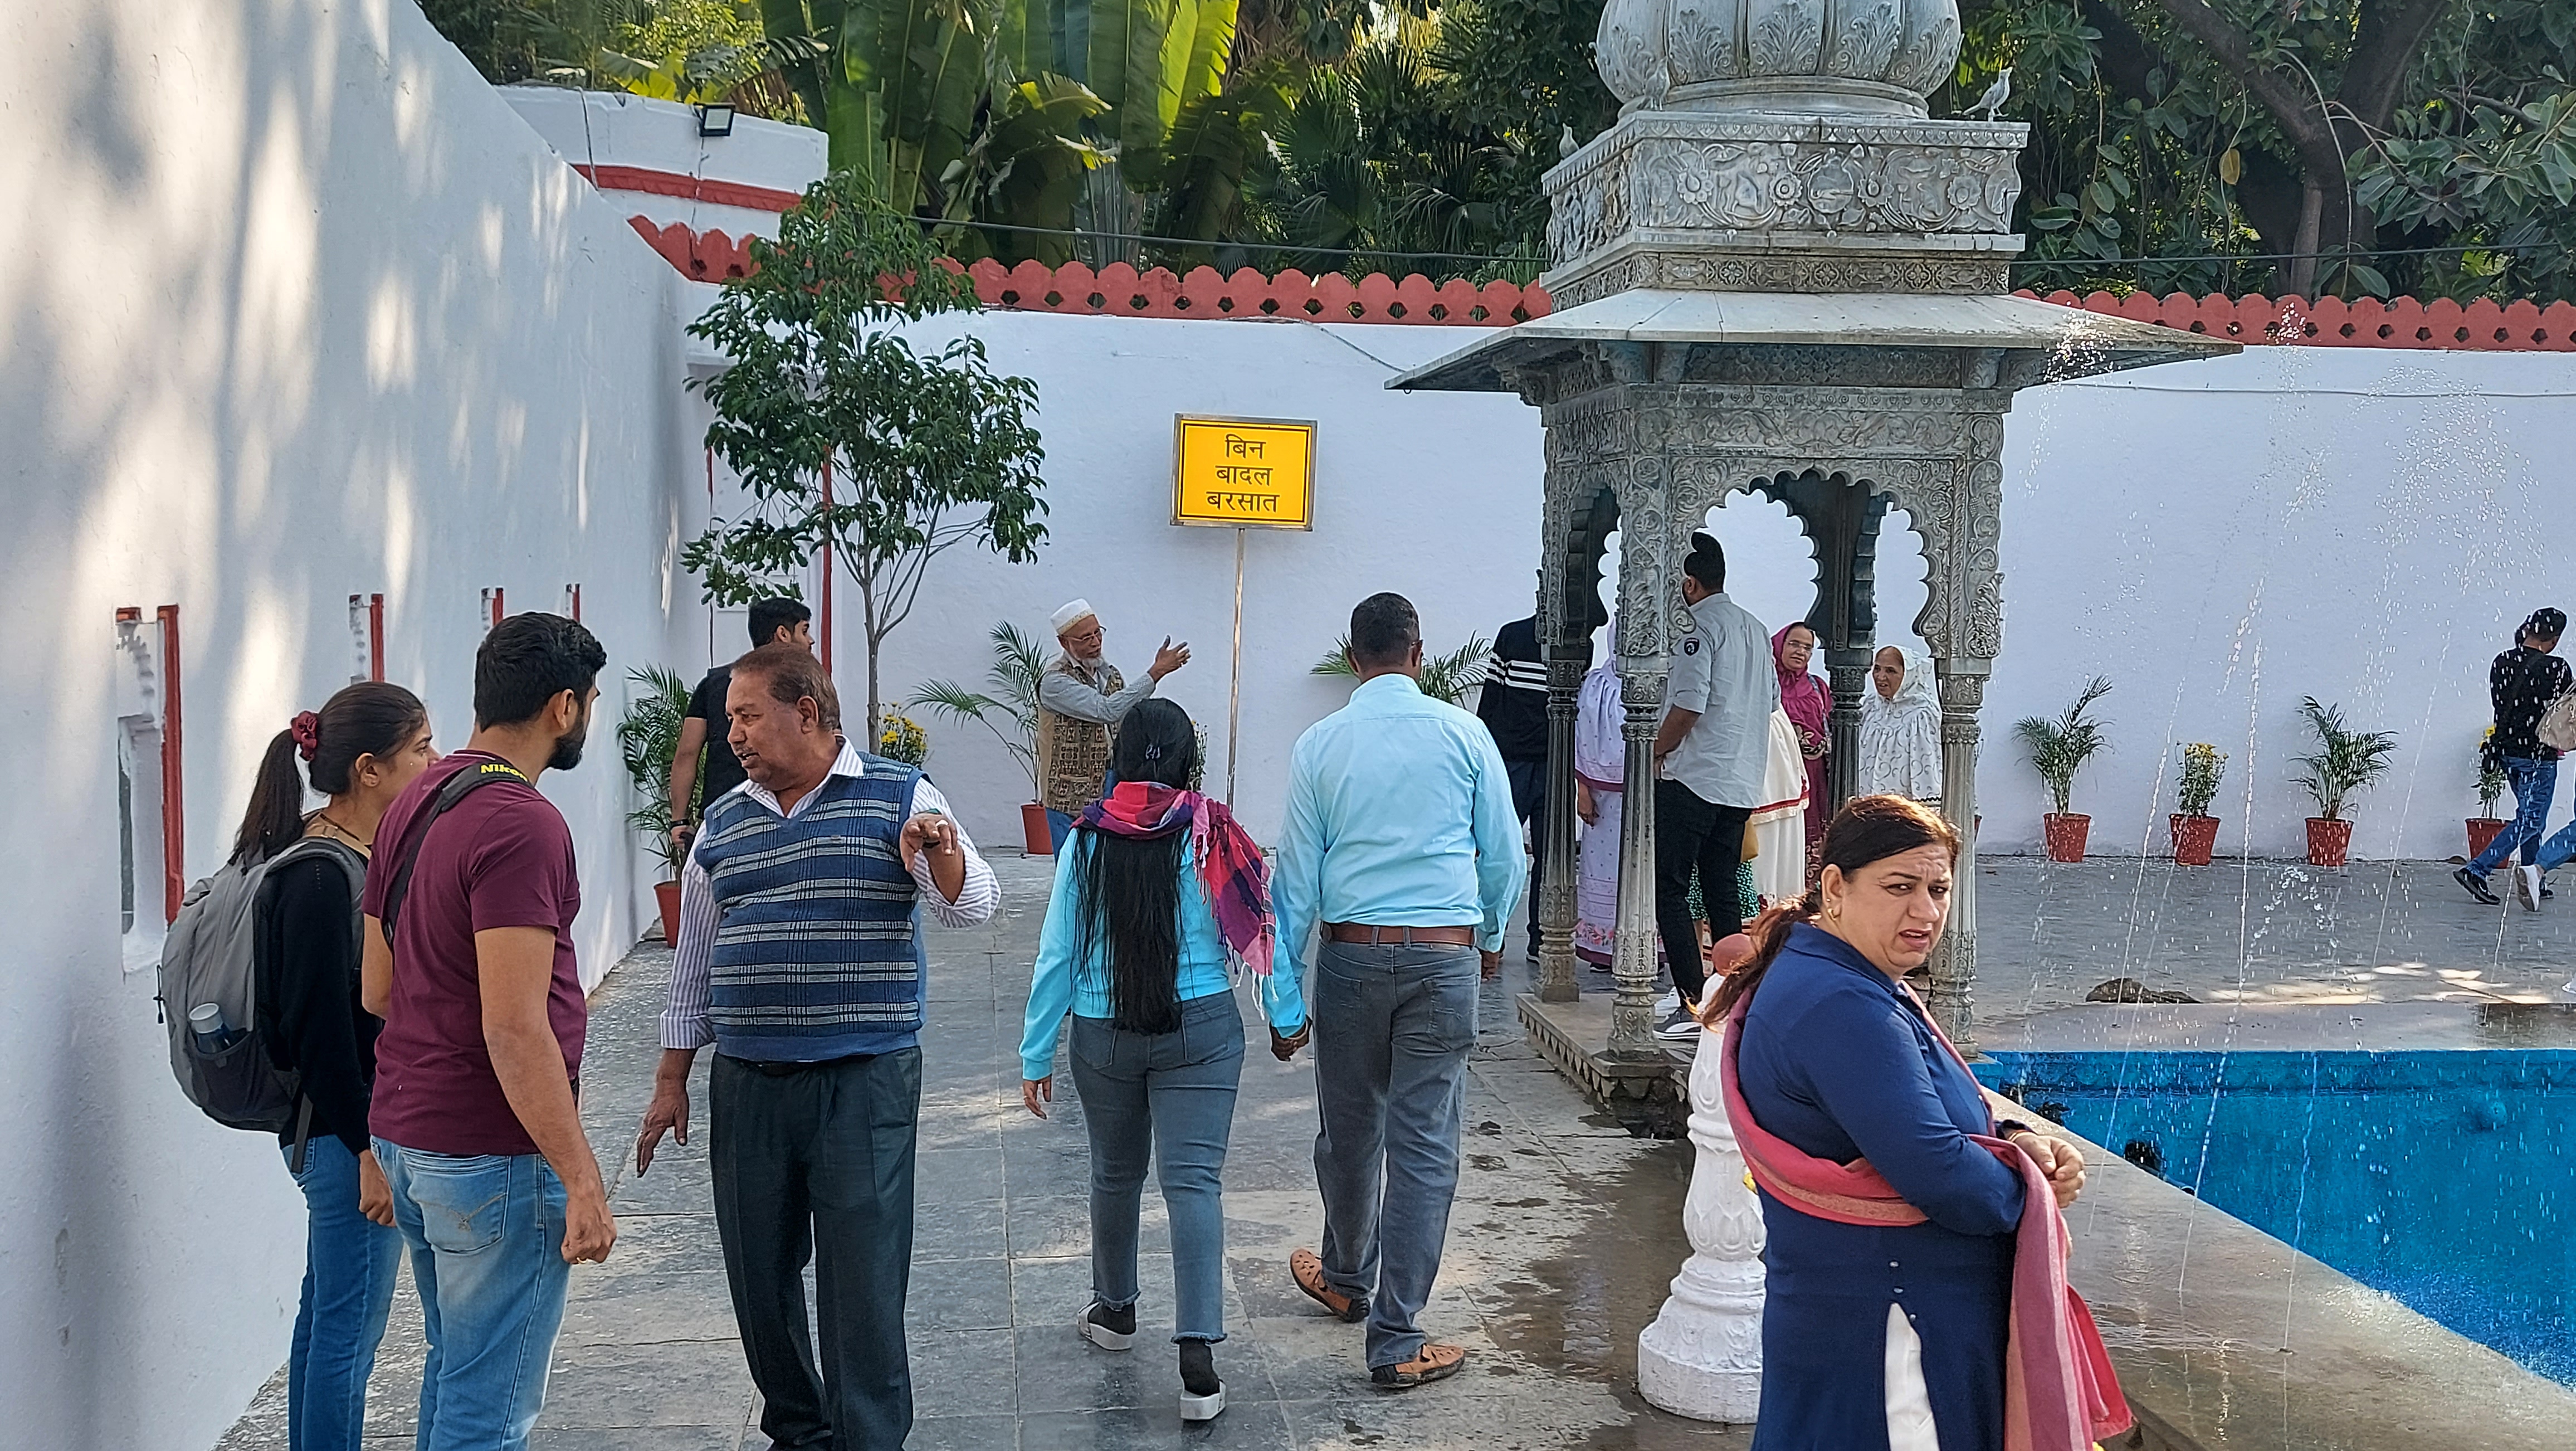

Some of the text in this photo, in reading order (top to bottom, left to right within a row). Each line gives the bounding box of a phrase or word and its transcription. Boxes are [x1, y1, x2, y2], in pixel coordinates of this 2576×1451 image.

[1225, 434, 1266, 459] बिन
[1215, 465, 1274, 486] बादल
[1206, 491, 1280, 513] बरसात
